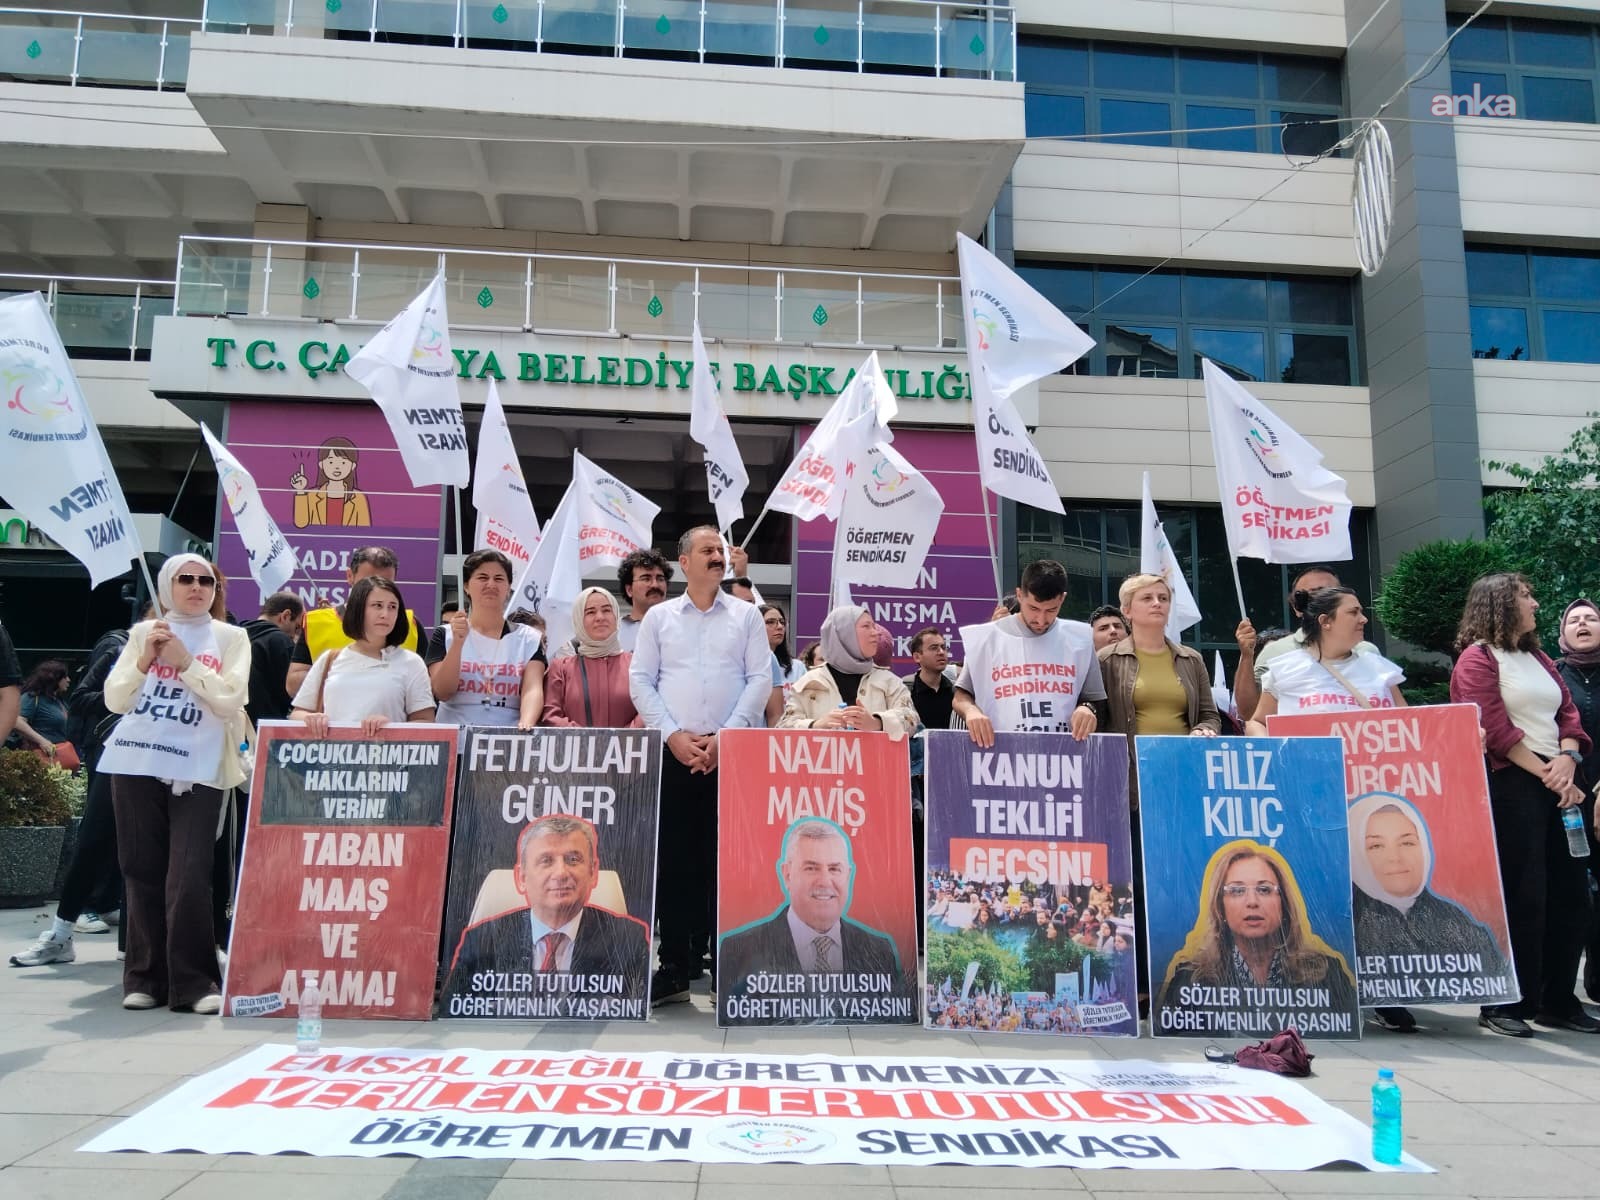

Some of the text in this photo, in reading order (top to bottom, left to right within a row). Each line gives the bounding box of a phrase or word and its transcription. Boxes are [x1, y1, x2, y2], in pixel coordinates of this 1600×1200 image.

[299, 340, 506, 381] ÇAYA
[861, 601, 957, 630] ANIŞMA
[991, 663, 1076, 683] ÖĞRETMEN
[994, 678, 1074, 700] SENDİKASI
[153, 680, 183, 700] İLE
[133, 692, 203, 727] ÜÇLÜ!
[1020, 699, 1053, 719] İLE
[278, 743, 440, 768] ÇOCUKLARIMIZIN
[469, 734, 648, 774] FETHULLAH
[768, 735, 864, 776] NAZIM
[1329, 717, 1422, 762] AYŞEN
[304, 771, 408, 792] HAKLARINI
[972, 751, 1083, 789] KANUN
[1205, 742, 1275, 791] FİLİZ
[323, 794, 387, 819] VERİN!
[502, 777, 617, 825] GÜNER
[767, 780, 866, 837] MAVİŞ
[972, 794, 1083, 837] TEKLİFİ
[1203, 797, 1284, 849] KILIÇ
[302, 832, 404, 867] TABAN
[299, 877, 389, 920] MAAŞ
[320, 923, 360, 958] VE
[1358, 953, 1483, 975] LER TUTULSUN
[280, 970, 397, 1007] ATAMA!
[472, 970, 624, 994] SÖZLER TUTULSUN
[746, 971, 892, 994] SÖZLER TUTULSUN
[1180, 983, 1330, 1007] SÖZLER TUTULSUN
[1426, 976, 1508, 1001] YAŞASIN!
[450, 994, 643, 1020] ÖĞRETMENLİK YAŞASIN!
[726, 994, 912, 1021] ÖĞRETMENLİK YAŞASIN!
[1160, 1006, 1351, 1036] ÖĞRETMENLİK YAŞASIN!
[265, 1054, 475, 1078] EMSAL
[488, 1054, 660, 1079] DEĞİL
[664, 1058, 1066, 1086] ÖĞRETMENİZ!
[253, 1075, 1279, 1125] VERİLEN SÖZLER TUTULSUN!
[350, 1115, 692, 1151] ÖĞRETMEN
[856, 1128, 1180, 1159] SENDİKASI
